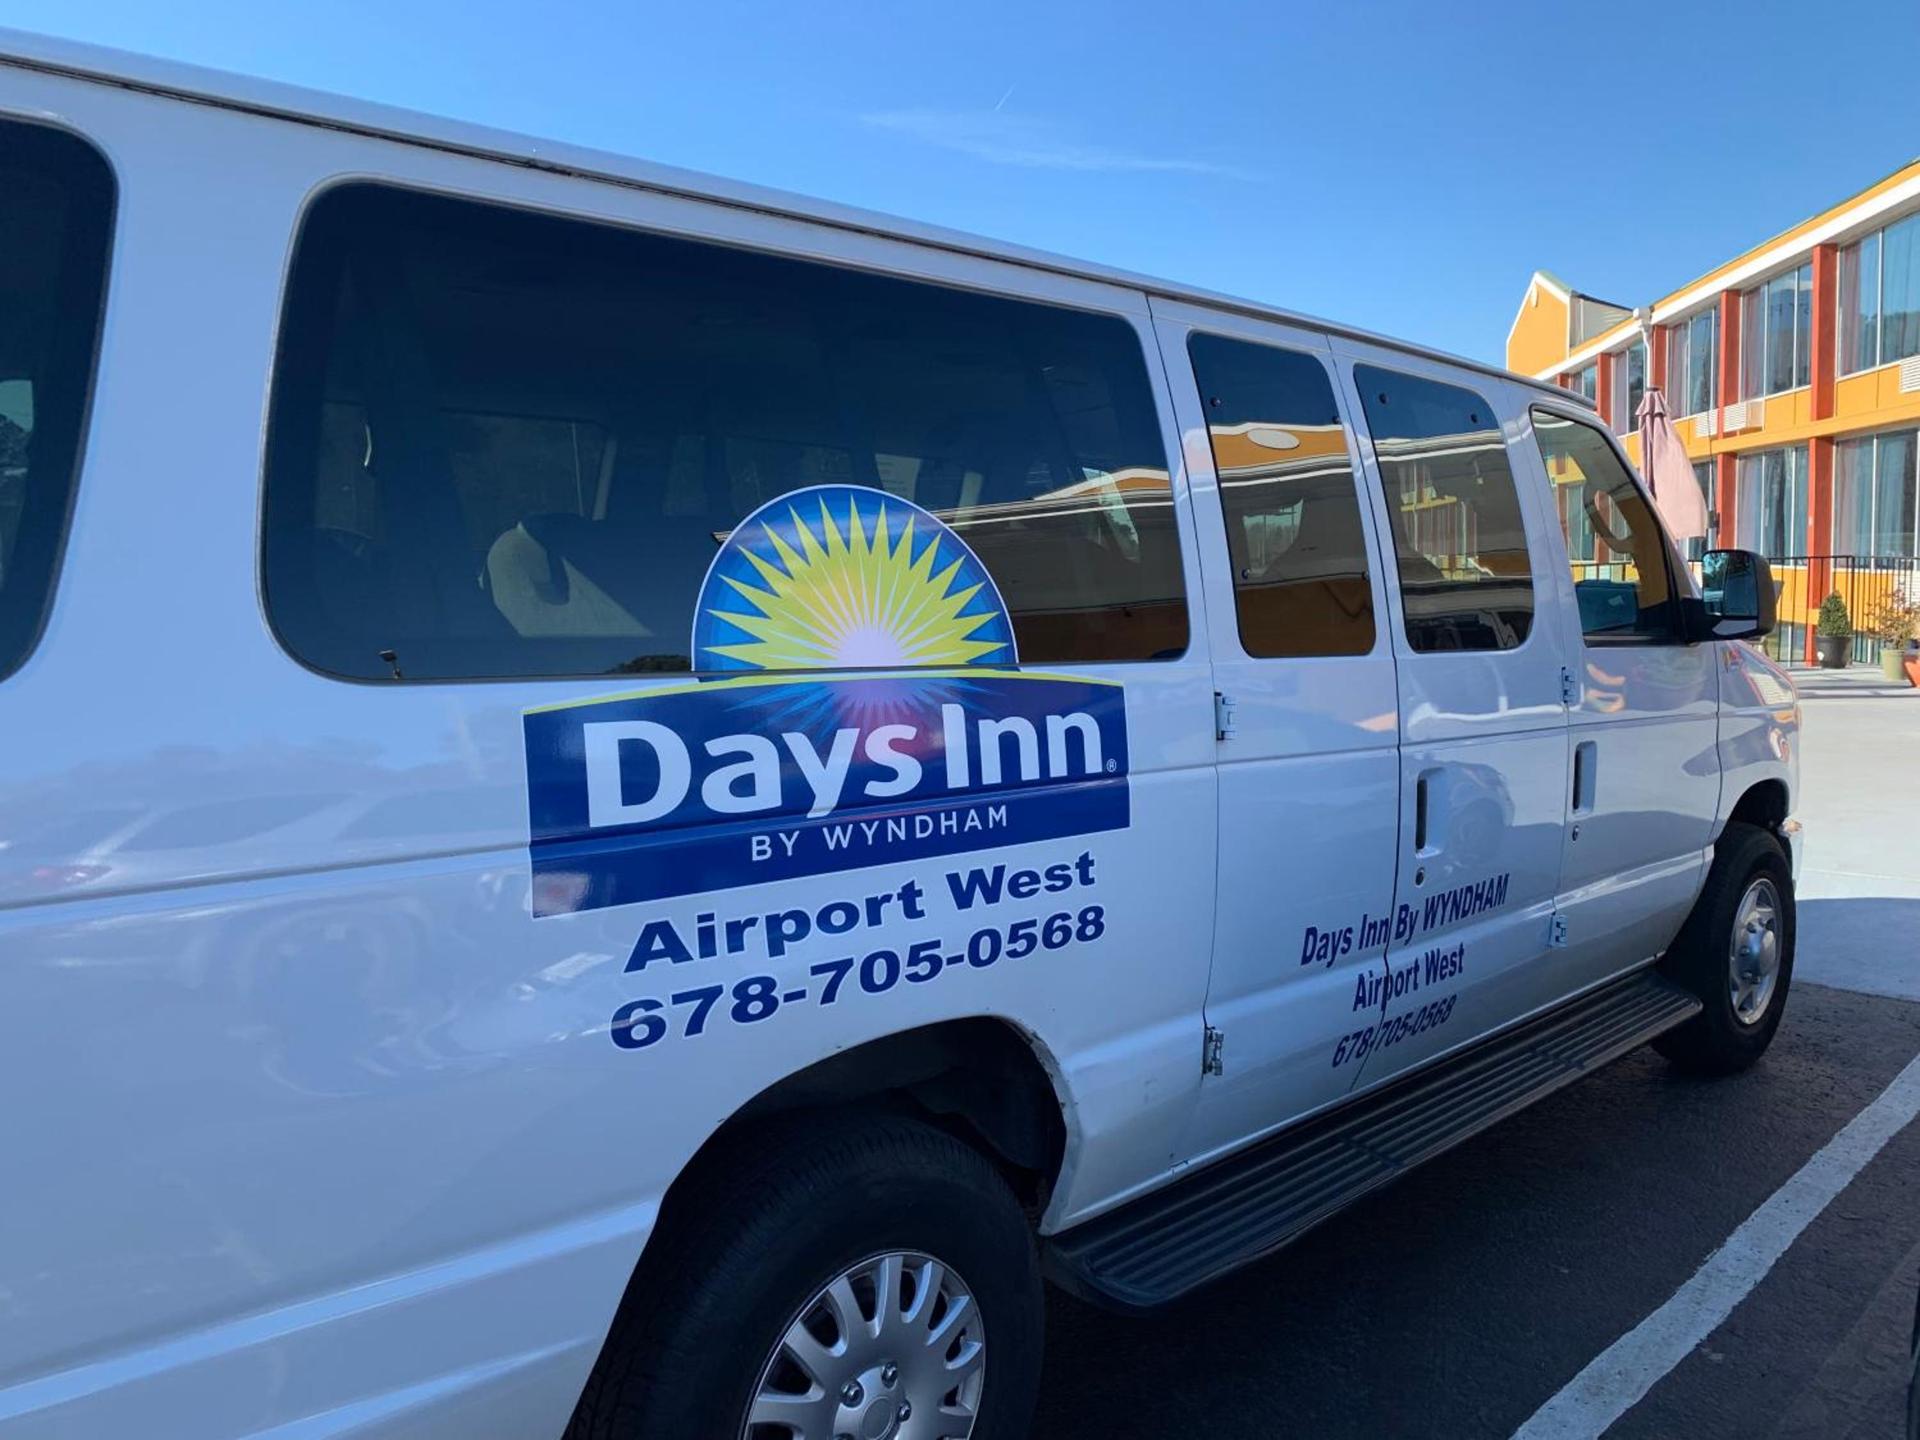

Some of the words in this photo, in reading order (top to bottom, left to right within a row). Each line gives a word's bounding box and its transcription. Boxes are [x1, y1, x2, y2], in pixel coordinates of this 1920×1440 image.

[583, 720, 922, 828] Days
[941, 703, 1104, 789] Inn
[751, 830, 801, 861] BY
[822, 804, 1008, 850] WYNDHAM
[624, 880, 924, 973] Airport
[945, 850, 1096, 910] West
[1300, 926, 1353, 968] Days
[1358, 913, 1390, 949] Inn
[1394, 903, 1419, 945] By
[1422, 873, 1509, 931] WYNDHAM
[609, 905, 1107, 1051] 678-705-0568
[1352, 957, 1420, 1013] Airport
[1424, 942, 1465, 986] West
[1331, 994, 1457, 1068] 678-705-0568
